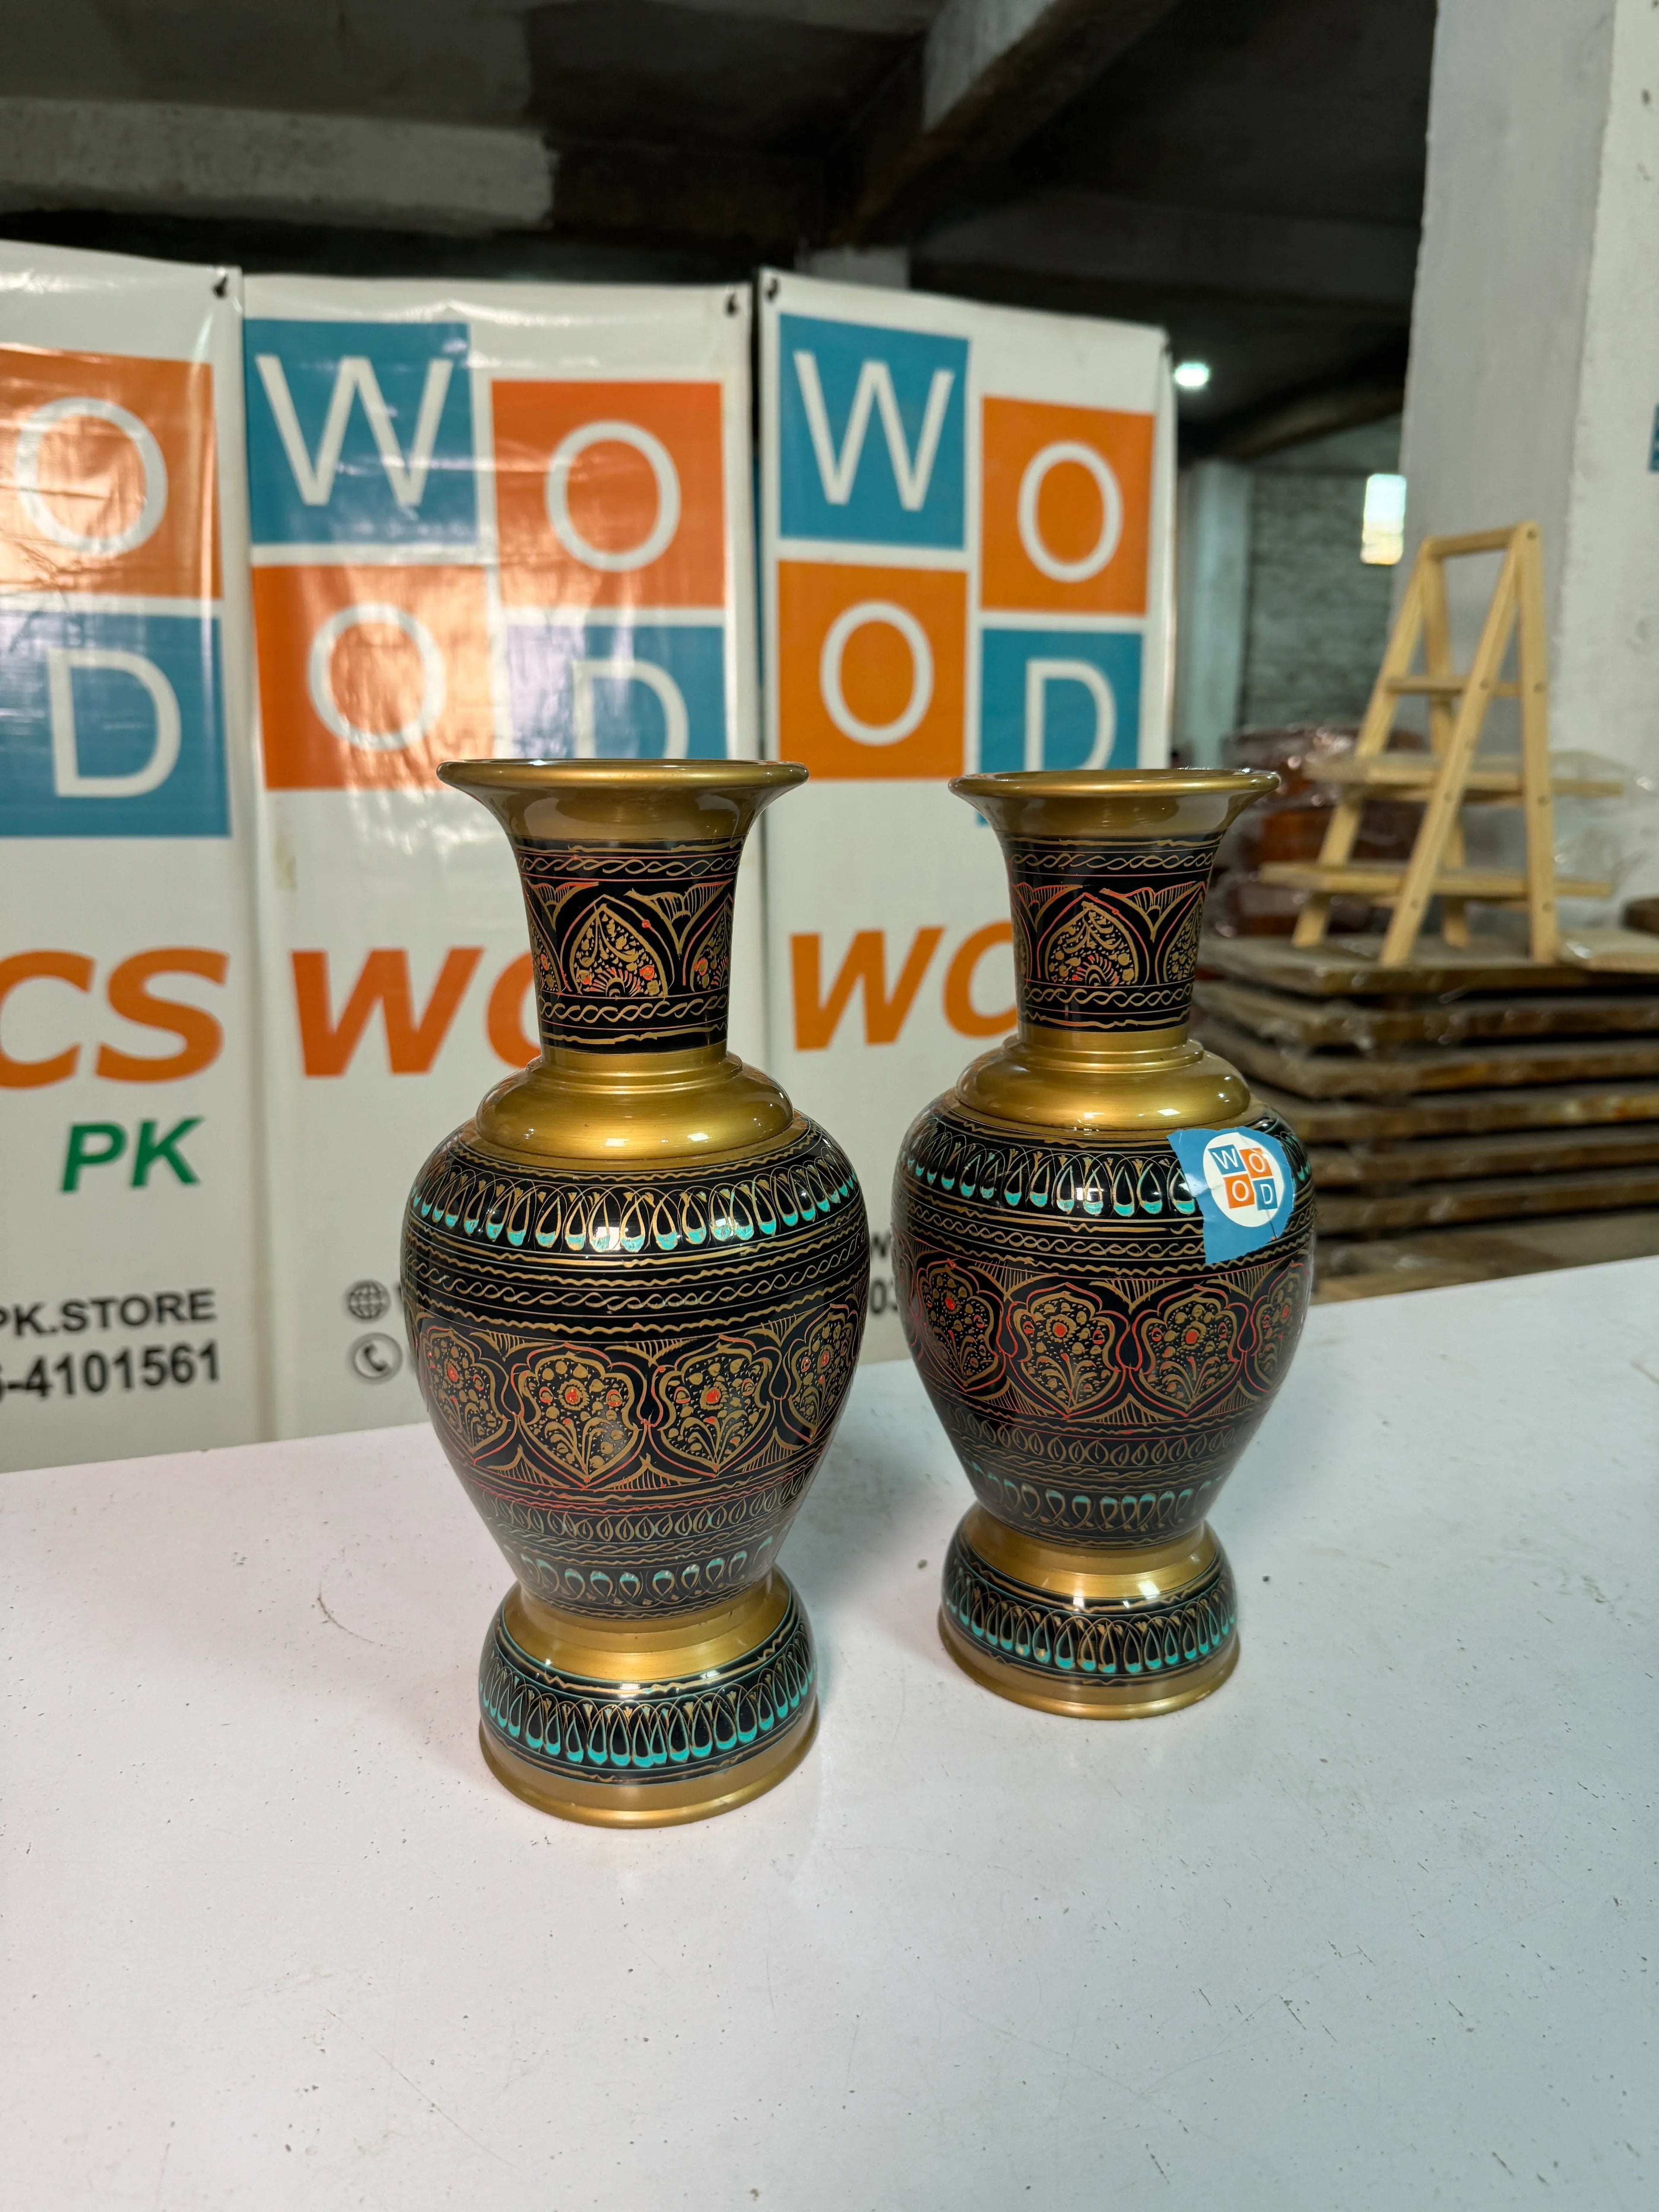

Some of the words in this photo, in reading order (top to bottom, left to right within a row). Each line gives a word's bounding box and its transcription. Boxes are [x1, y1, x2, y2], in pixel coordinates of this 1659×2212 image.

[0, 945, 230, 1091] CS
[60, 1116, 205, 1194] PK
[0, 1339, 220, 1401] -4101561
